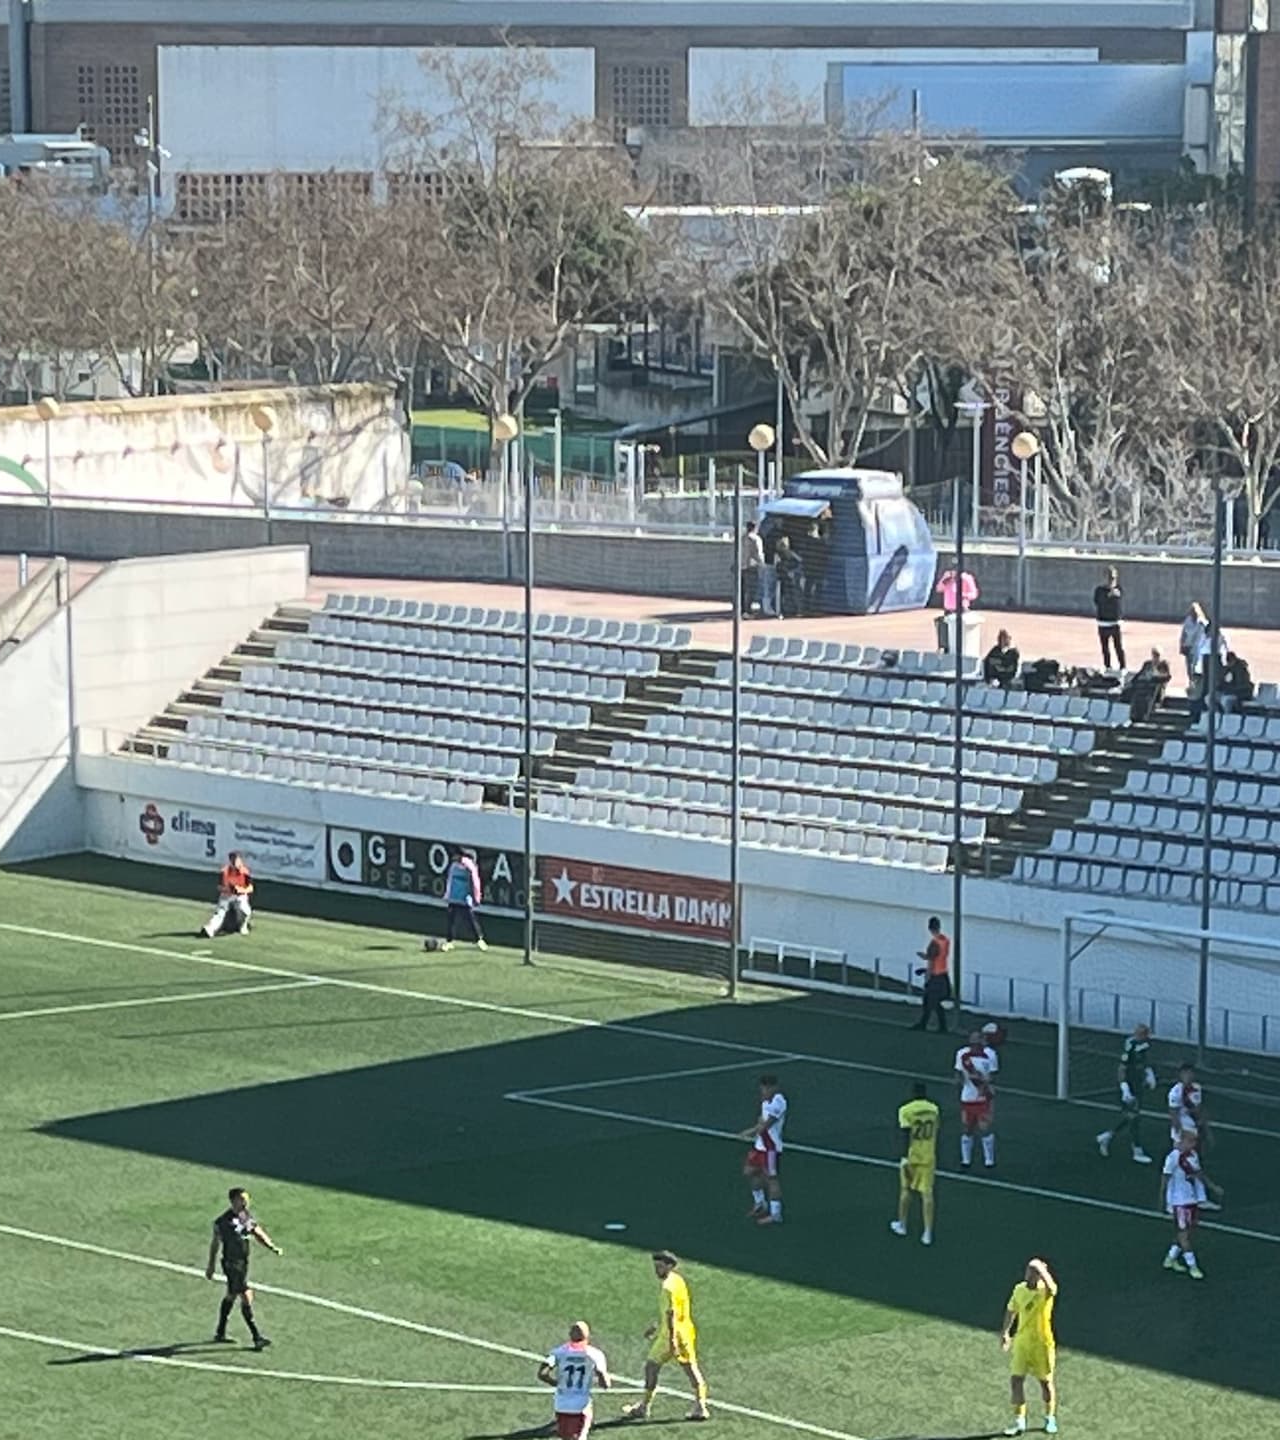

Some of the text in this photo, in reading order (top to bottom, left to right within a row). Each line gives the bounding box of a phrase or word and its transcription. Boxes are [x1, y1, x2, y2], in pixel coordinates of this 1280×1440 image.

[205, 839, 216, 857] 5
[368, 835, 544, 886] GLOAL
[370, 868, 543, 913] PERFOANCE
[580, 882, 671, 920] ESTRELLA
[912, 1119, 934, 1140] 20
